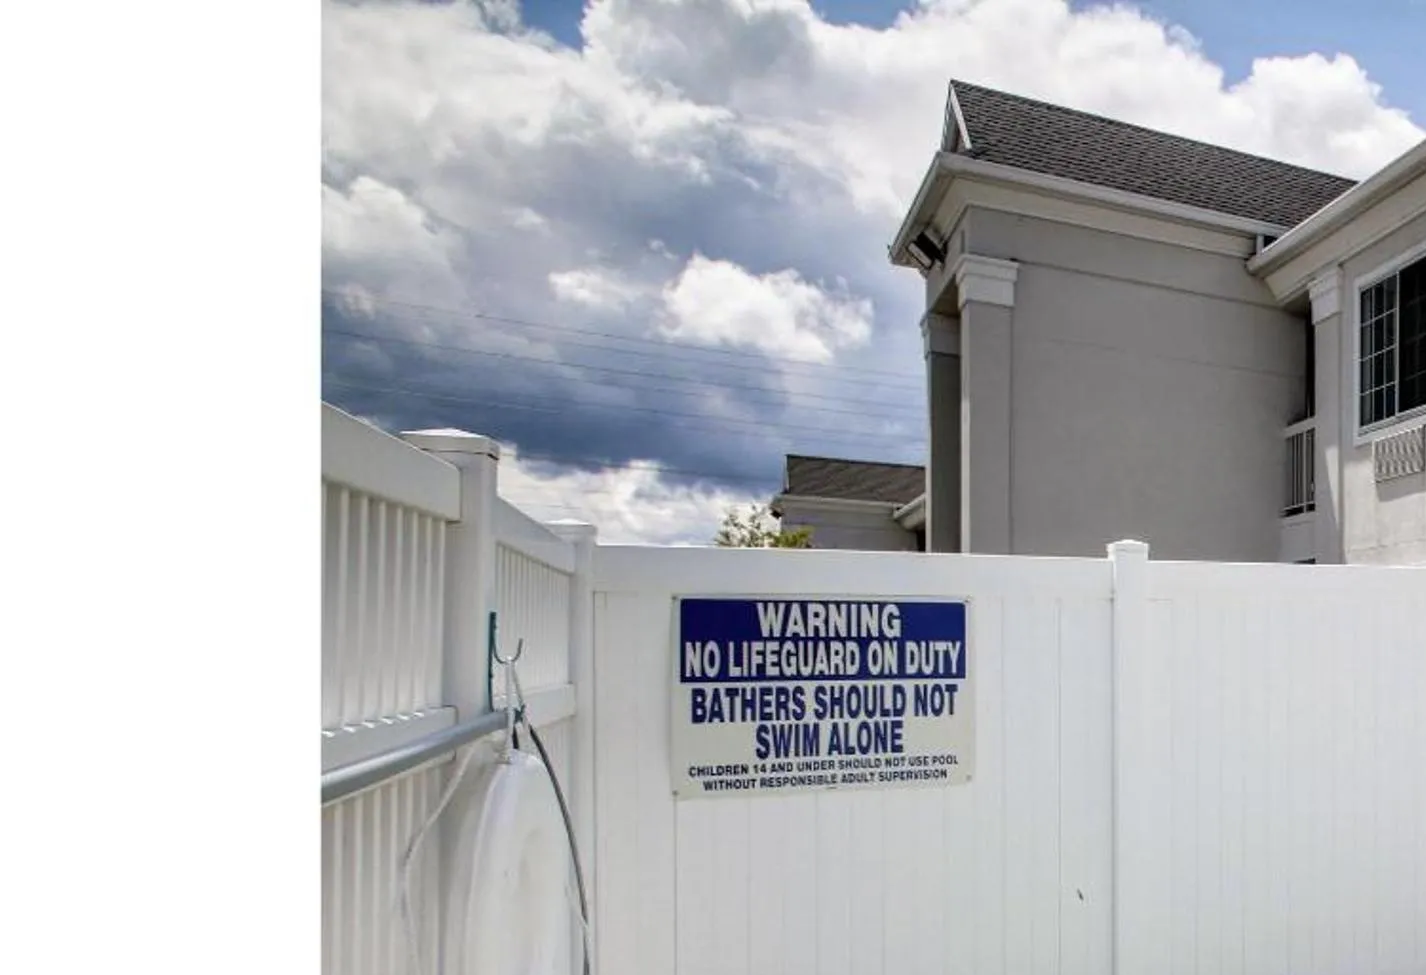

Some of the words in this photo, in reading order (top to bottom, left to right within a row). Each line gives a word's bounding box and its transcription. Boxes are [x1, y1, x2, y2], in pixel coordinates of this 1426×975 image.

[757, 603, 901, 638] WARNING
[685, 641, 720, 677] NO
[728, 641, 860, 677] LIFEGUARD
[867, 640, 897, 676] ON
[905, 640, 961, 675] DUTY
[691, 685, 806, 724] BATHERS
[813, 684, 905, 721] SHOULD
[914, 683, 958, 717] NOT
[755, 723, 820, 759] SWIM
[828, 721, 903, 756] ALONE
[689, 764, 749, 777] CHILDREN
[753, 764, 767, 774] 14
[771, 762, 793, 773] AND
[797, 760, 835, 772] UNDER
[838, 758, 881, 770] SHOULD
[885, 757, 905, 768] NOT
[908, 756, 929, 767] USE
[932, 755, 958, 765] POOL
[703, 779, 756, 791] WITHOUT
[760, 774, 836, 788] RESPONSIBLE
[841, 772, 875, 783] ADULT
[879, 769, 947, 781] SUPERVISION
